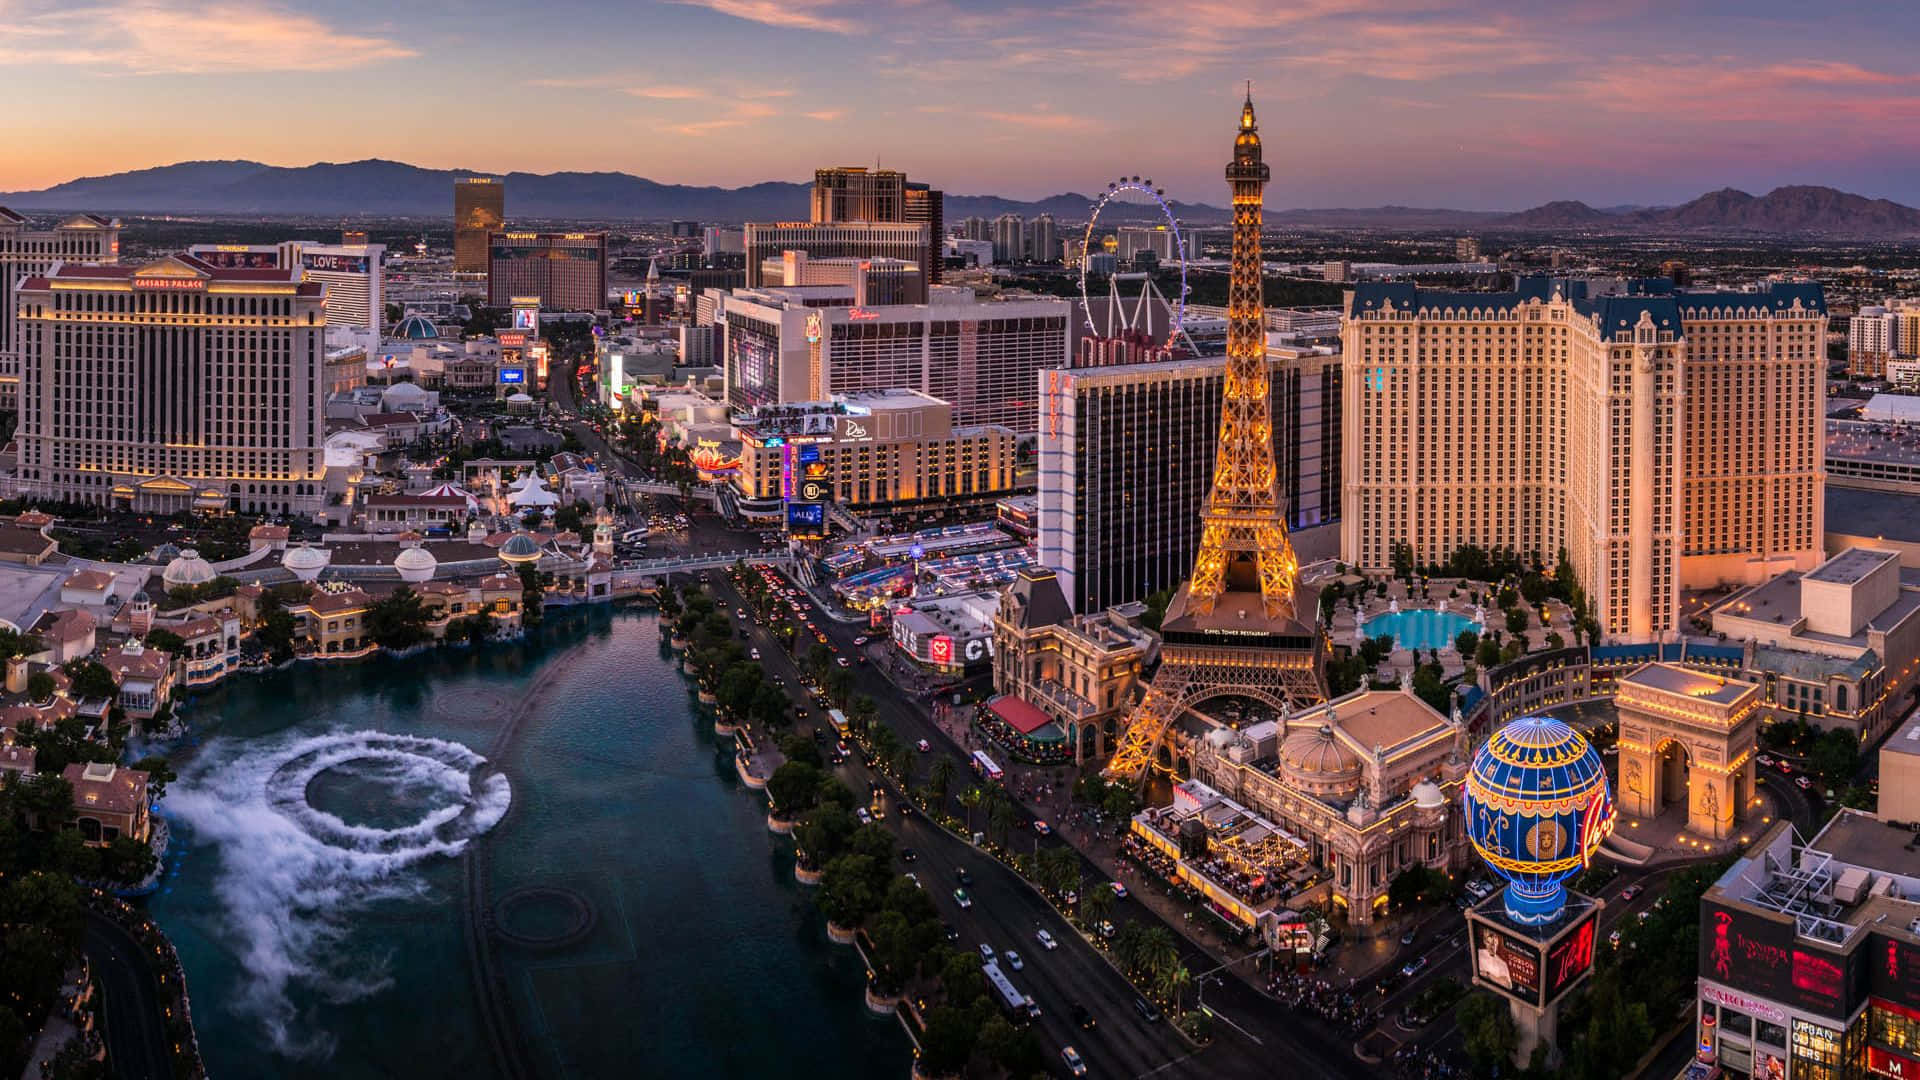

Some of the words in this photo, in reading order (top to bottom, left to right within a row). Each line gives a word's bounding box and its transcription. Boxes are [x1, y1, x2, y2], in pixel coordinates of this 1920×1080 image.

[313, 257, 338, 268] LOVE
[135, 280, 169, 288] CAESARS
[172, 280, 203, 288] PALACE
[893, 618, 917, 654] CVS
[1582, 793, 1618, 869] Paris
[1792, 1020, 1833, 1041] URBAN
[1792, 1044, 1820, 1061] TERS
